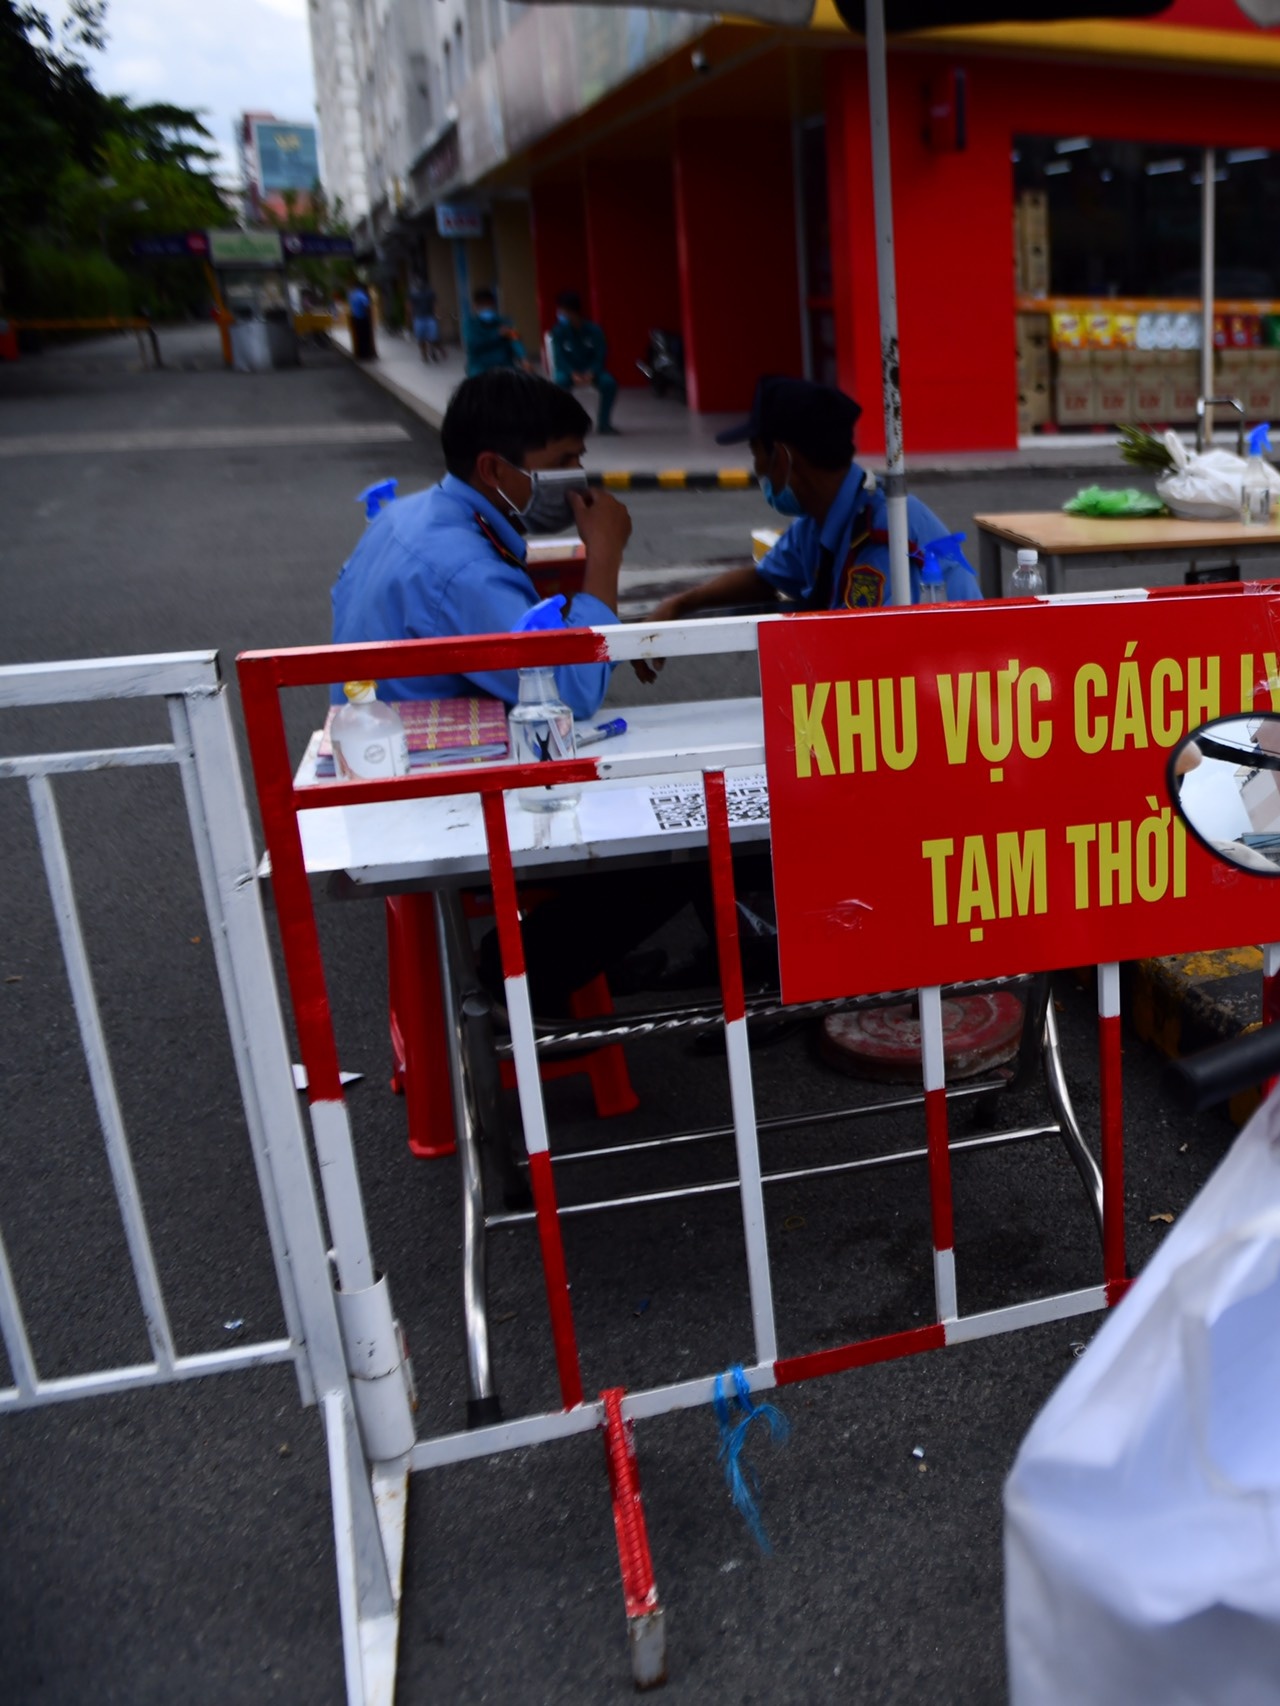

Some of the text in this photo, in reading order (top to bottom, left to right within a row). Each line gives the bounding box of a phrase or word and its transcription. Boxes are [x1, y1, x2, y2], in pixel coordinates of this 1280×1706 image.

[791, 677, 917, 778] KHU
[937, 659, 1052, 782] VỰC
[1073, 641, 1220, 753] CÁCH
[922, 796, 1186, 941] TẠM THỜI
